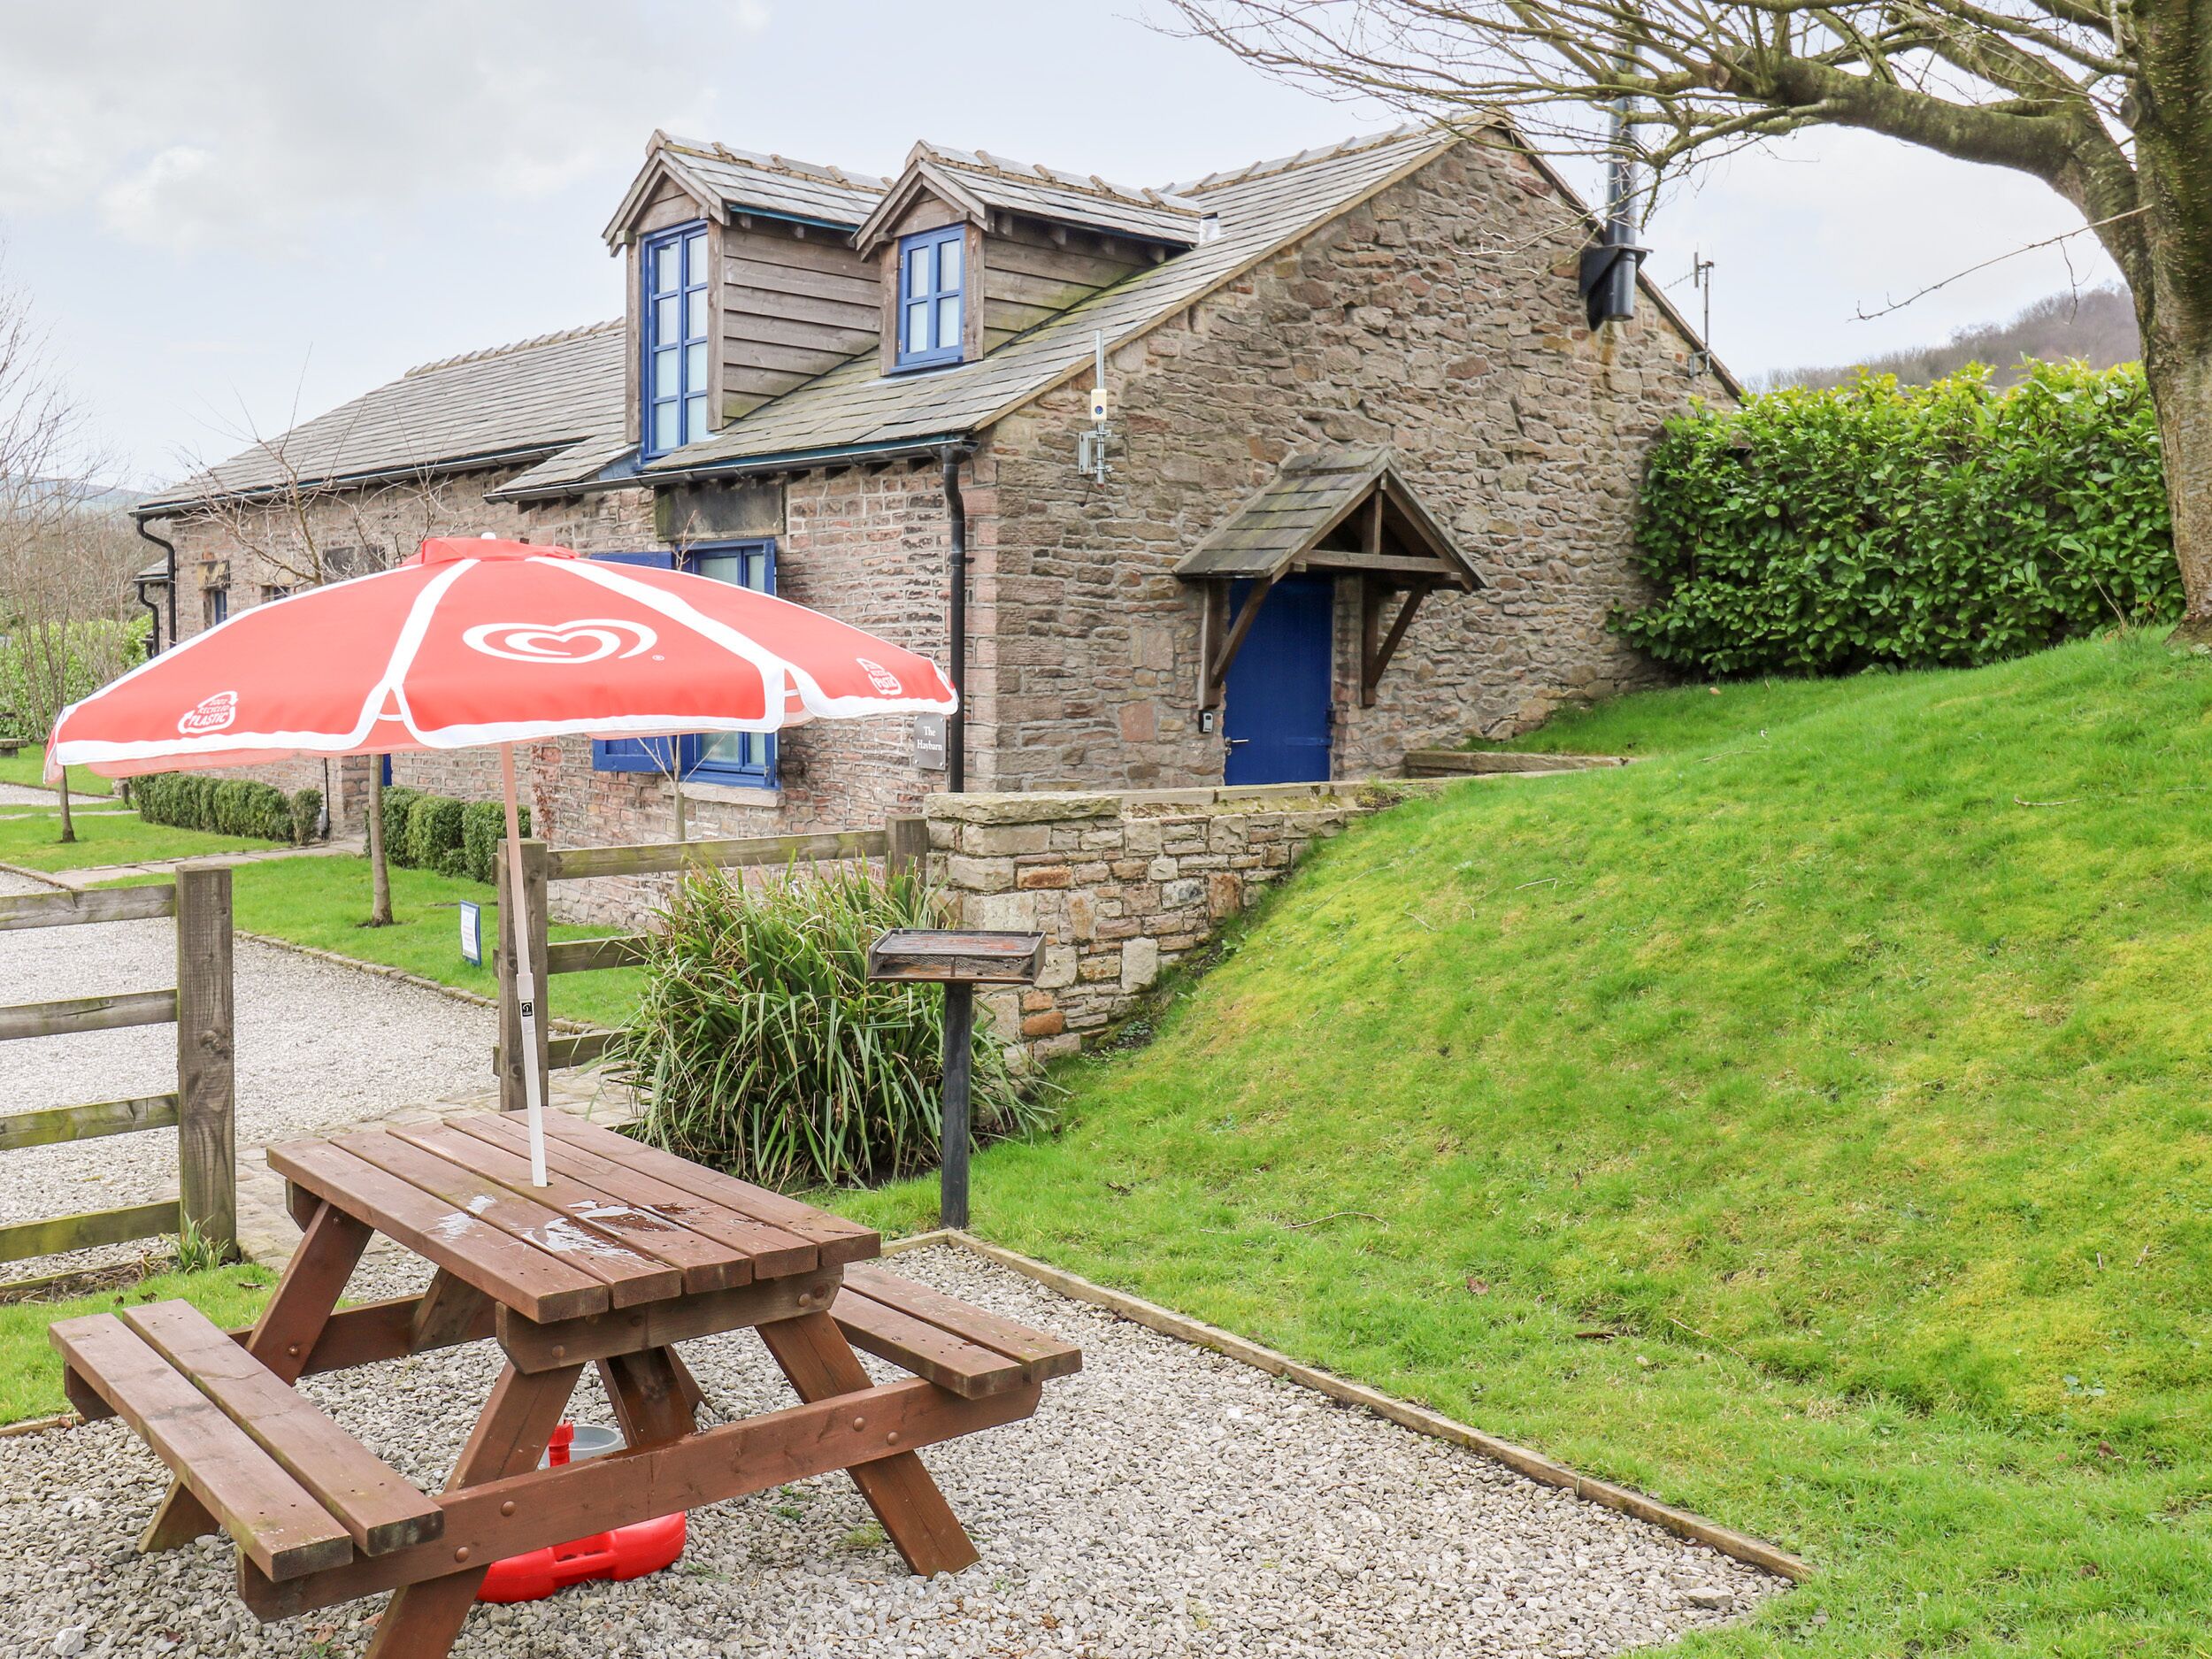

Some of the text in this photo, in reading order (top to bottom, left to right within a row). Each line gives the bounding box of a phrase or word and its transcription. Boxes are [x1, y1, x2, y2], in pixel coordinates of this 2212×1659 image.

[188, 712, 229, 726] PLASTIC
[923, 726, 936, 737] The
[917, 739, 942, 751] Haybarn
